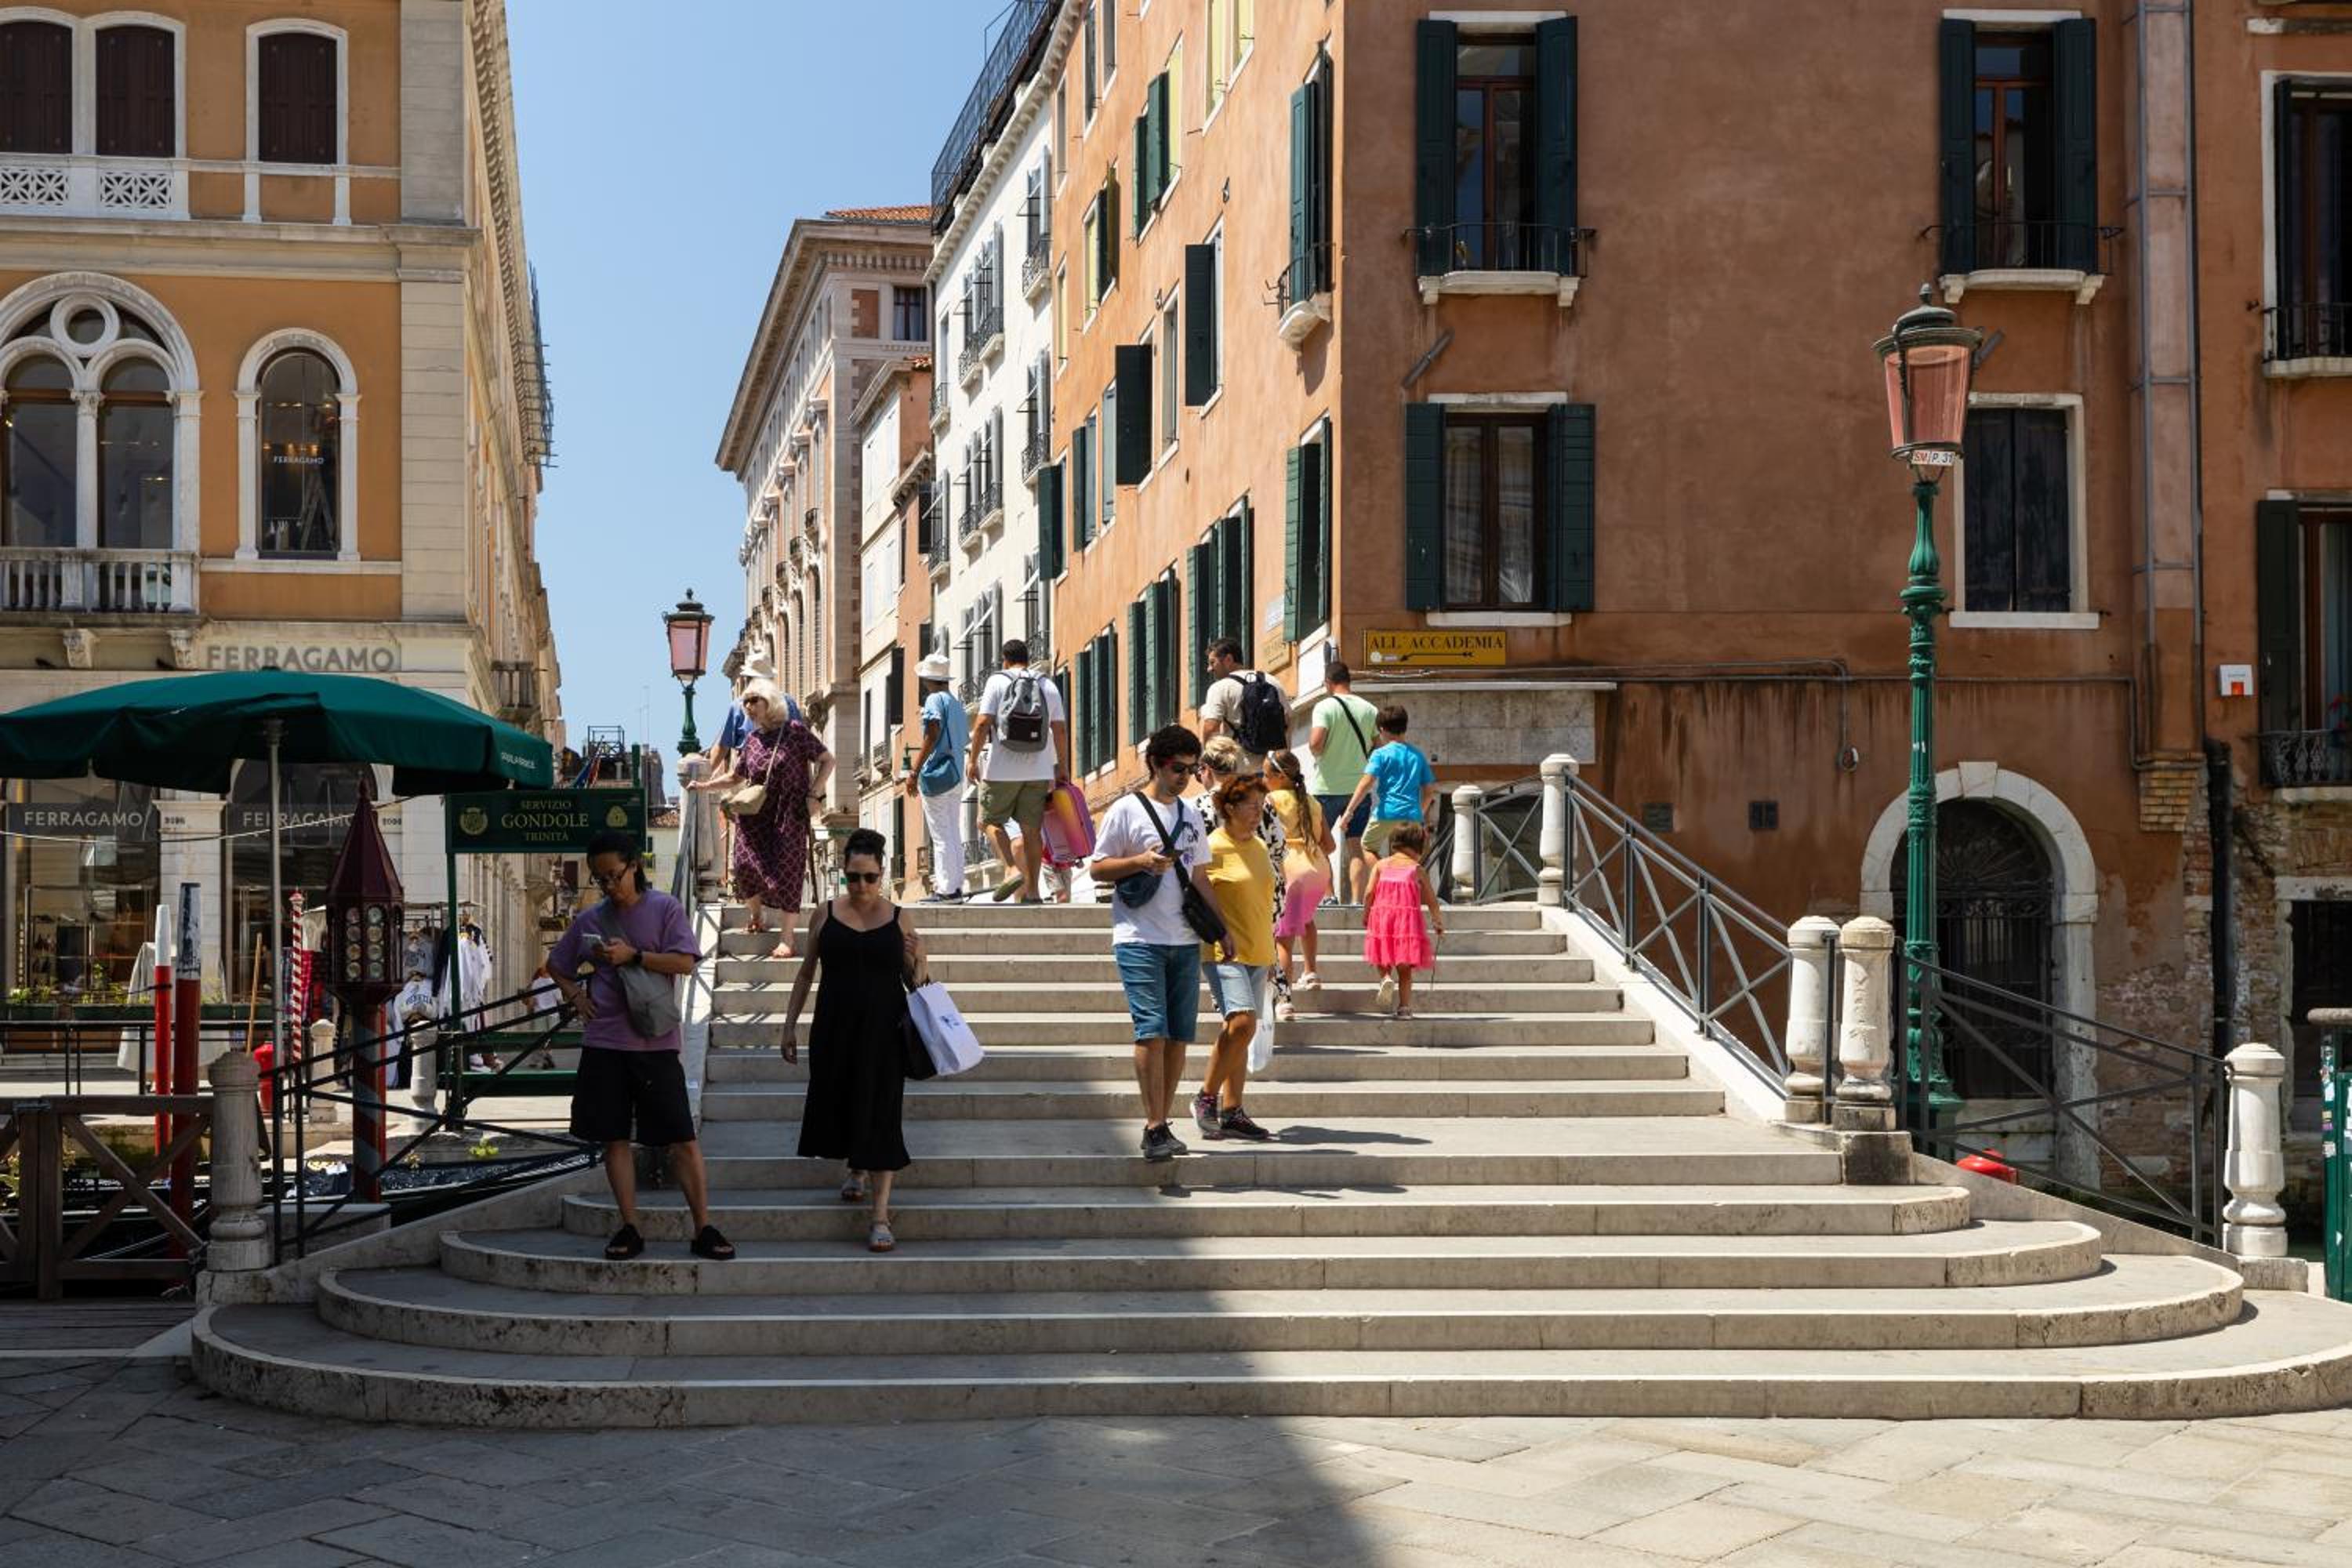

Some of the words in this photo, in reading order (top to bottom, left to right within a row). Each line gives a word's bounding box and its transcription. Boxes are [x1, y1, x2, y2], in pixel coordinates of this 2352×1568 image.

[206, 645, 394, 672] FERRAGAMO
[520, 800, 572, 810] SERVIZIO
[24, 811, 143, 827] FERRAGAMO
[501, 812, 590, 829] GONDOLE
